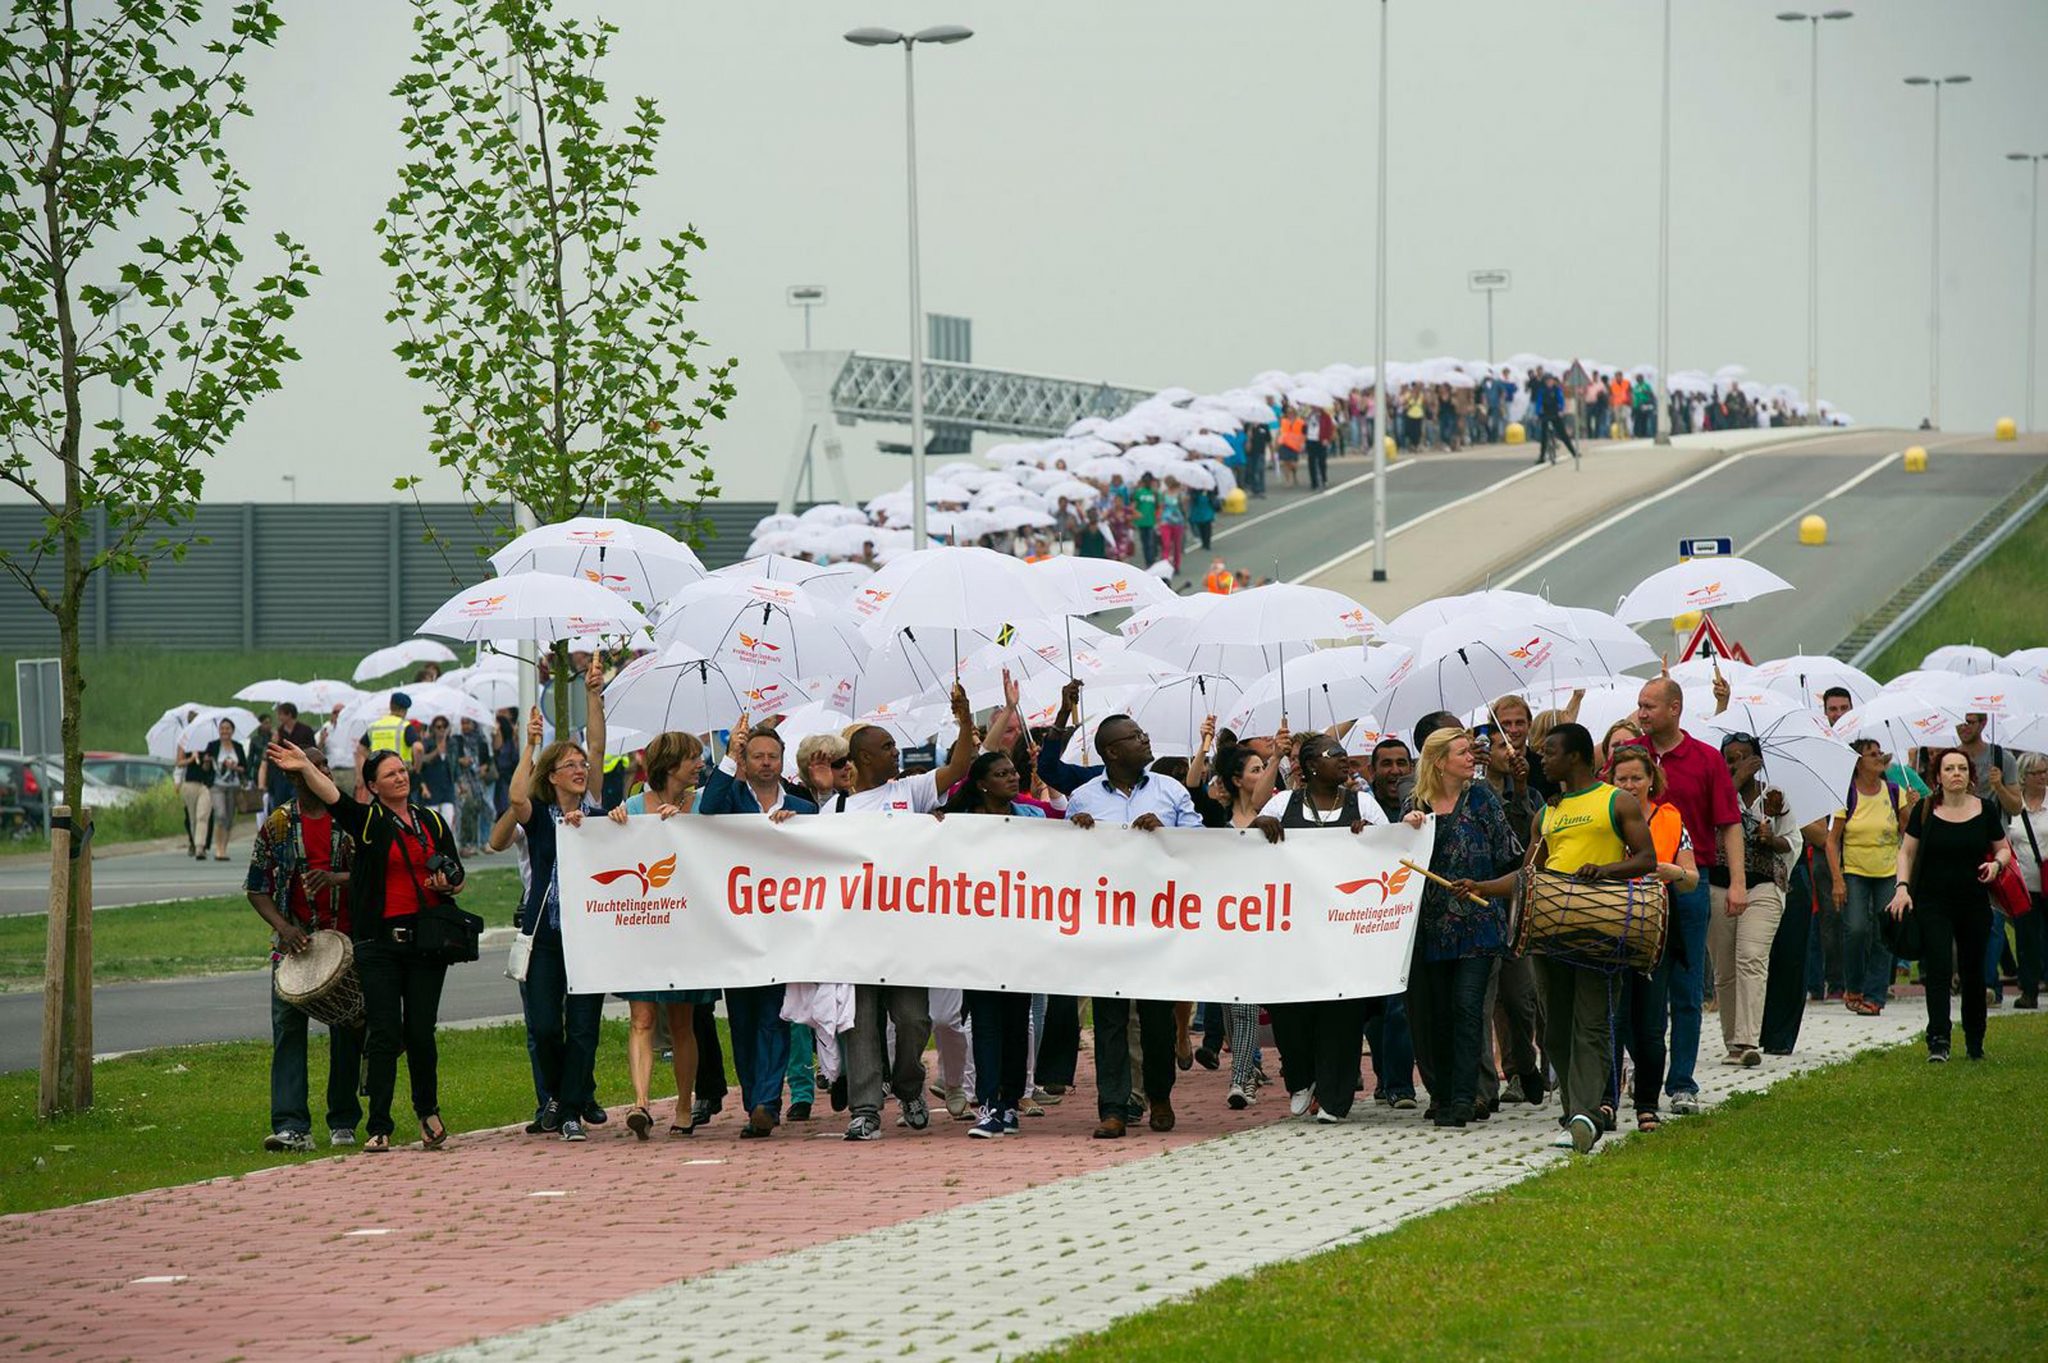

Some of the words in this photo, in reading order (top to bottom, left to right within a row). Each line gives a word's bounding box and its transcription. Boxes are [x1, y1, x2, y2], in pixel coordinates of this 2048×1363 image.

[586, 897, 687, 913] VluchtelingenWerk
[726, 865, 827, 916] Geen
[839, 861, 1082, 937] vluchteling
[1094, 875, 1136, 928] in
[1151, 879, 1202, 931] de
[1216, 882, 1292, 933] cel!
[615, 912, 670, 926] Nederland
[1328, 902, 1414, 921] VluchtelingenWerk
[1353, 918, 1401, 935] Nederland
